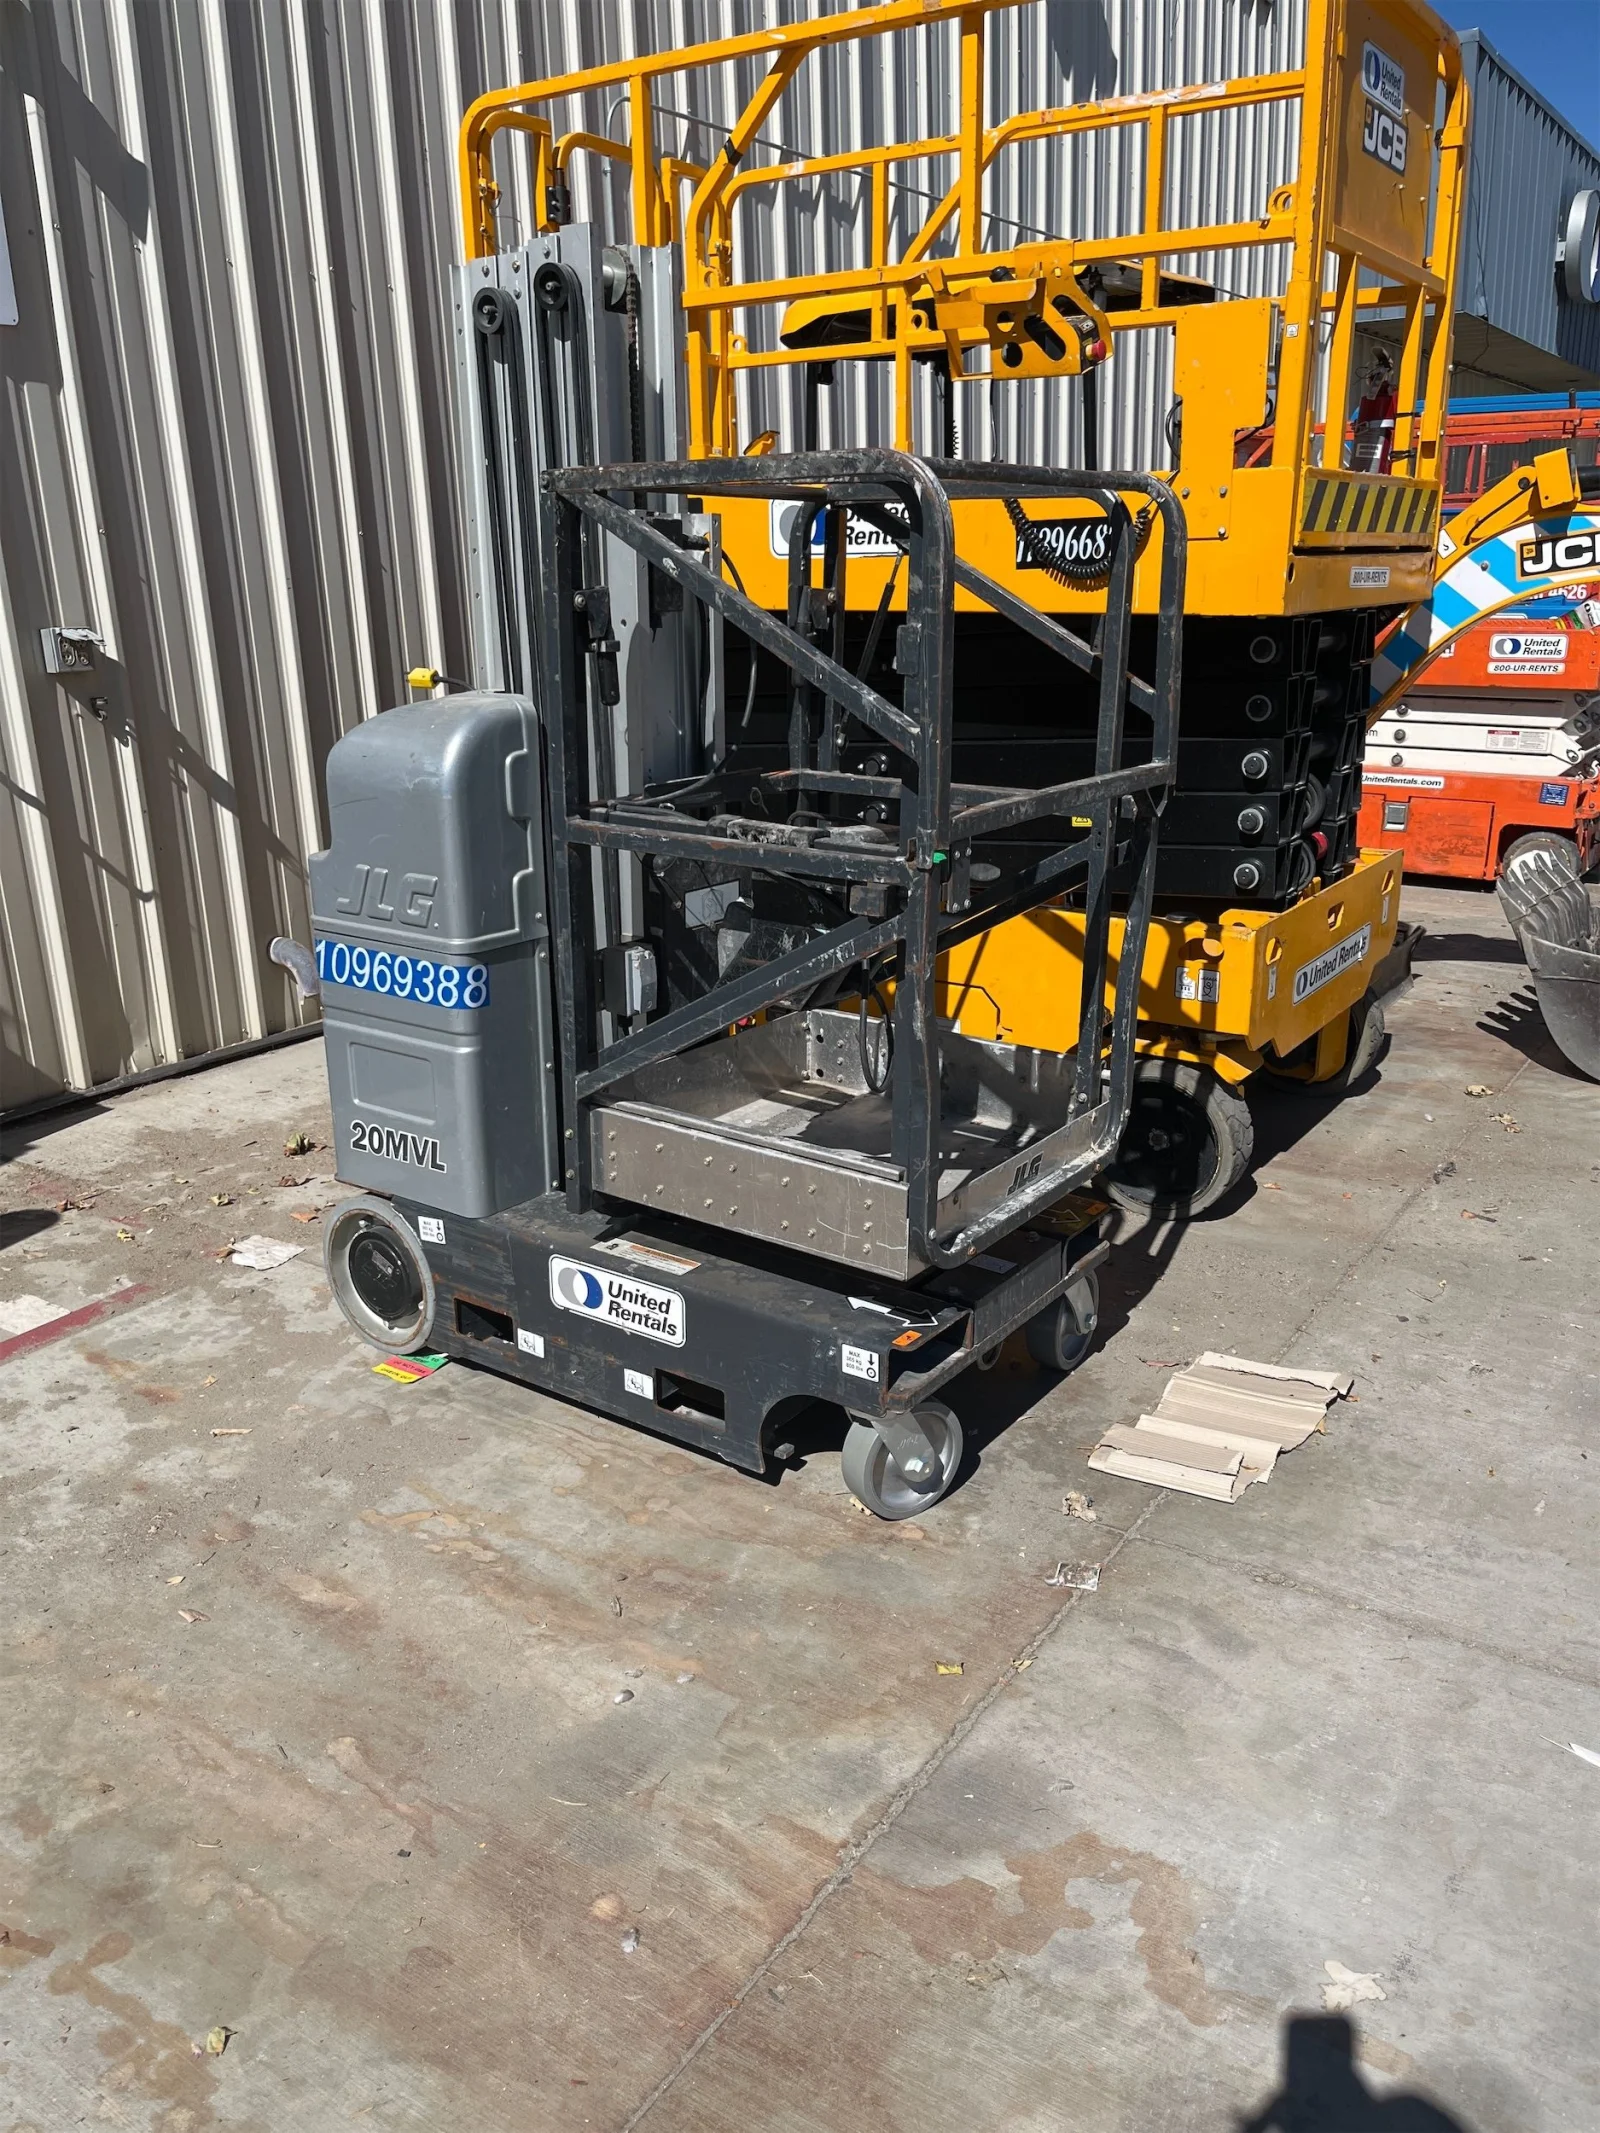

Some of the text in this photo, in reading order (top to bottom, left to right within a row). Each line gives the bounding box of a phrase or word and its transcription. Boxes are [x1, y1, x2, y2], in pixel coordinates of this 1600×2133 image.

[1382, 62, 1402, 90] United
[1381, 83, 1402, 110] Rentals
[1364, 109, 1407, 171] JCB
[1523, 533, 1600, 573] JC
[1523, 647, 1562, 656] Rentals
[1524, 638, 1561, 647] United
[337, 863, 439, 928] JLG
[316, 939, 488, 1009] 10969388
[1309, 935, 1367, 987] United Rentas
[351, 1119, 447, 1174] 20MVL
[1006, 1150, 1044, 1197] JLG
[608, 1280, 671, 1315] United
[608, 1300, 677, 1337] Rentals
